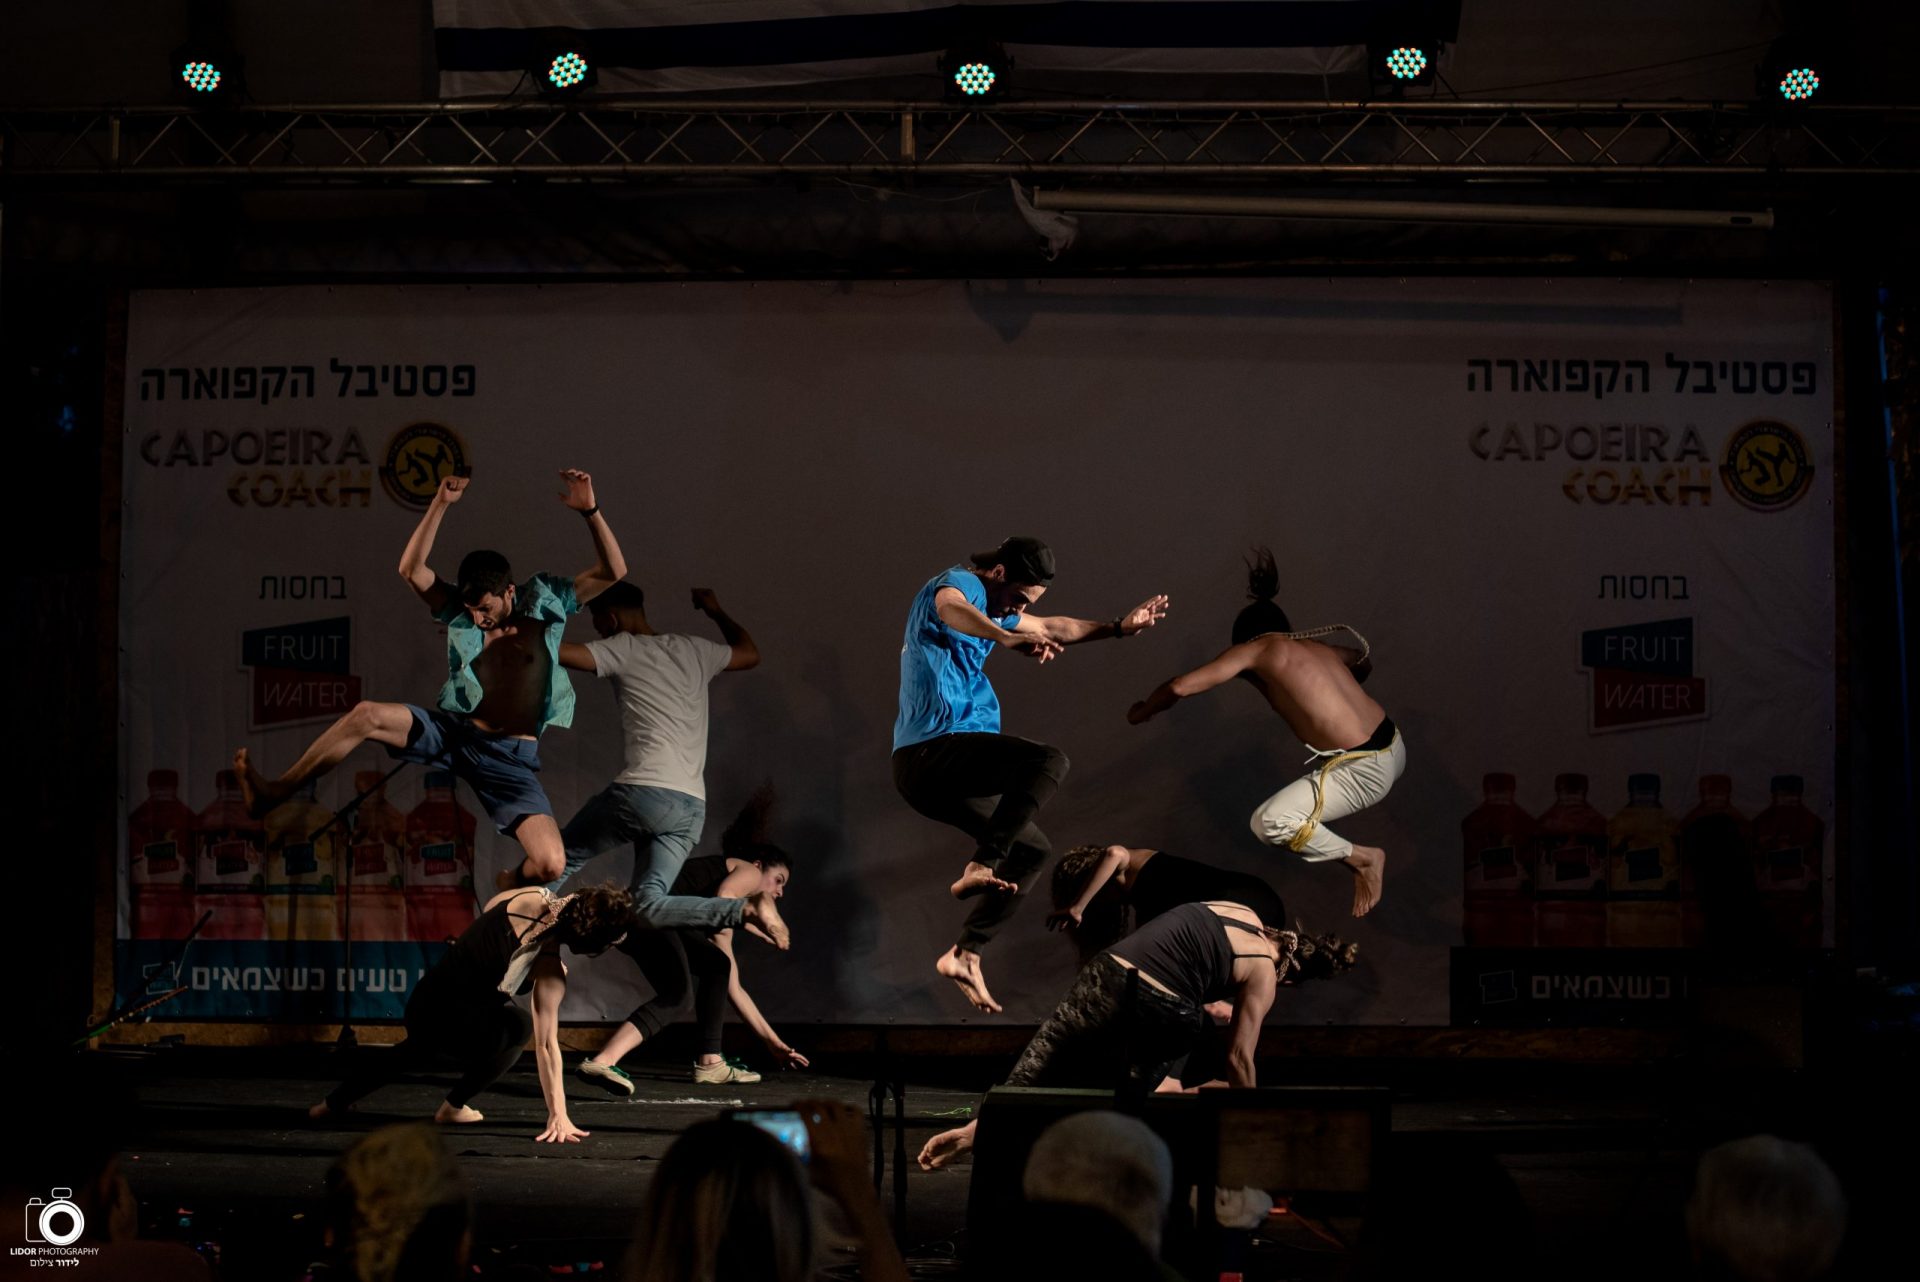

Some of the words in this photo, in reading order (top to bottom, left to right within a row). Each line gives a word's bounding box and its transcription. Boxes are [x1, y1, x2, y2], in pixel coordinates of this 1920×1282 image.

[141, 366, 314, 404] הקפוארה
[330, 358, 475, 397] פסטיבל
[1468, 359, 1649, 399] הקפוארה
[1666, 353, 1816, 394] פסטיבל
[140, 428, 370, 467] CAPOEIRA
[1468, 423, 1710, 462] CAPOEIRA
[227, 471, 372, 508] COACH
[1562, 467, 1711, 507] COACH
[259, 575, 347, 600] בחסות
[1598, 575, 1689, 600] בחסות
[263, 634, 344, 662] FRUIT
[1603, 635, 1686, 663] FRUIT
[263, 681, 349, 708] WATER
[1603, 683, 1691, 710] WATER
[191, 966, 326, 992] כשצמאים
[1531, 974, 1671, 1000] כשצמאים
